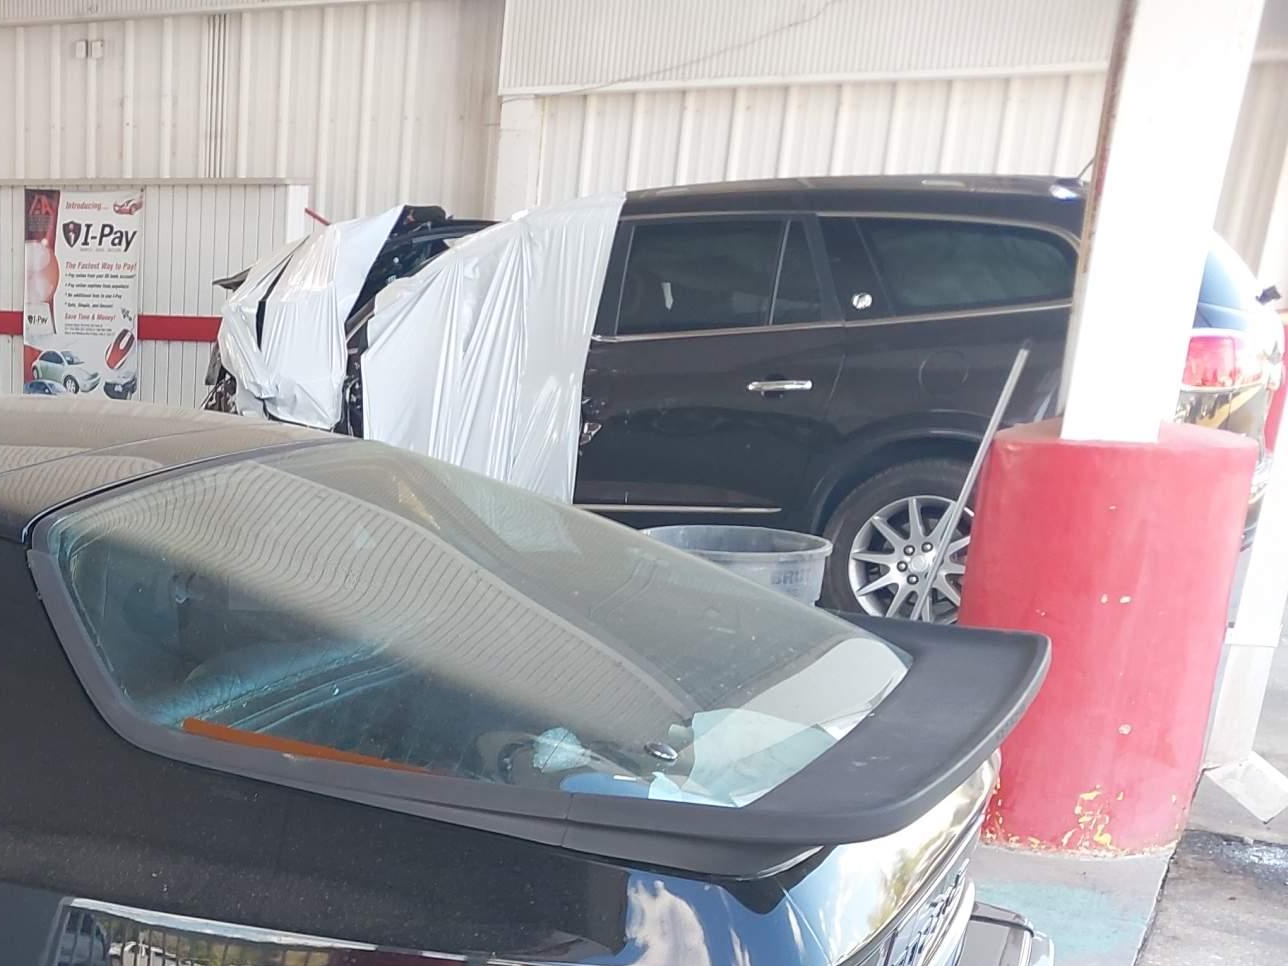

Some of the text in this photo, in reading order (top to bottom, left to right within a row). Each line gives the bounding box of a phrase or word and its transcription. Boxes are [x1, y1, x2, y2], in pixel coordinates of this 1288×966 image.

[81, 223, 138, 253] I-Pay
[66, 261, 137, 272] The Fastest Way to Pay!
